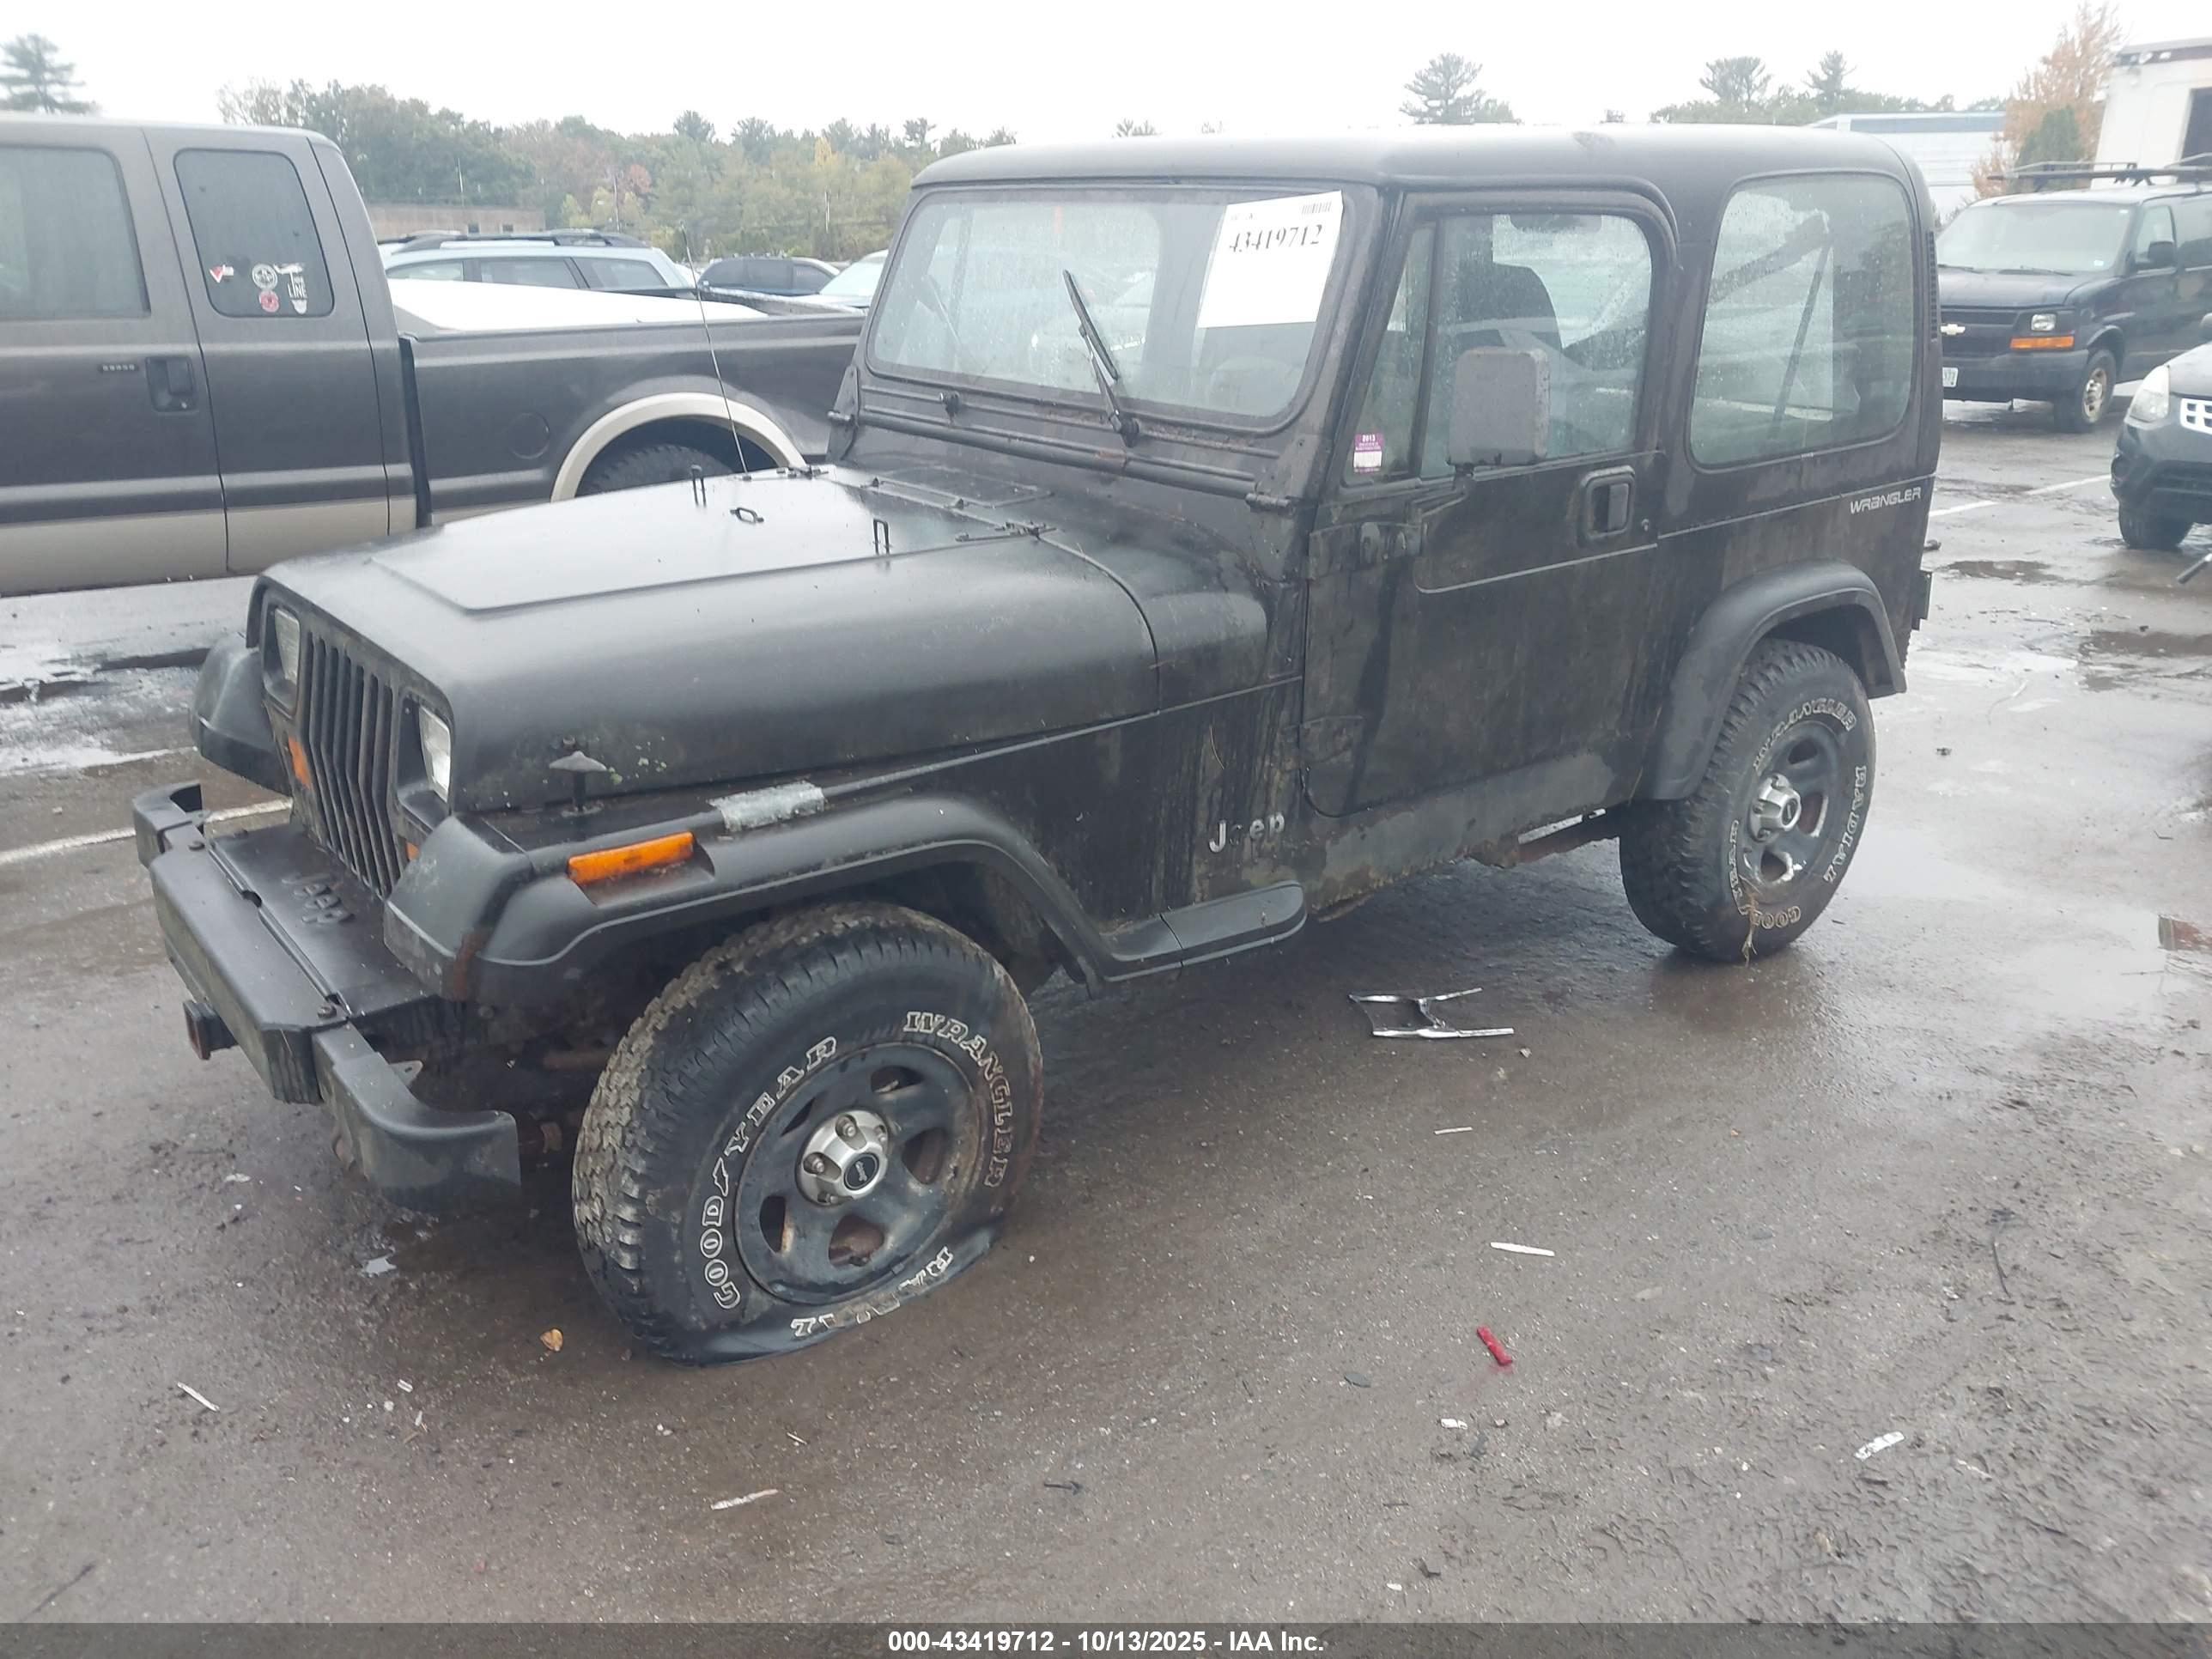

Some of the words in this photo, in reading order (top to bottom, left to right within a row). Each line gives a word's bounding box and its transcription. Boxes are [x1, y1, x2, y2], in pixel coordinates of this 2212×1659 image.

[1229, 223, 1322, 252] 43419712
[1850, 486, 1922, 514] WRANGLER
[903, 1011, 1013, 1188] WRANGLER
[700, 1036, 836, 1310] GOODYEAR
